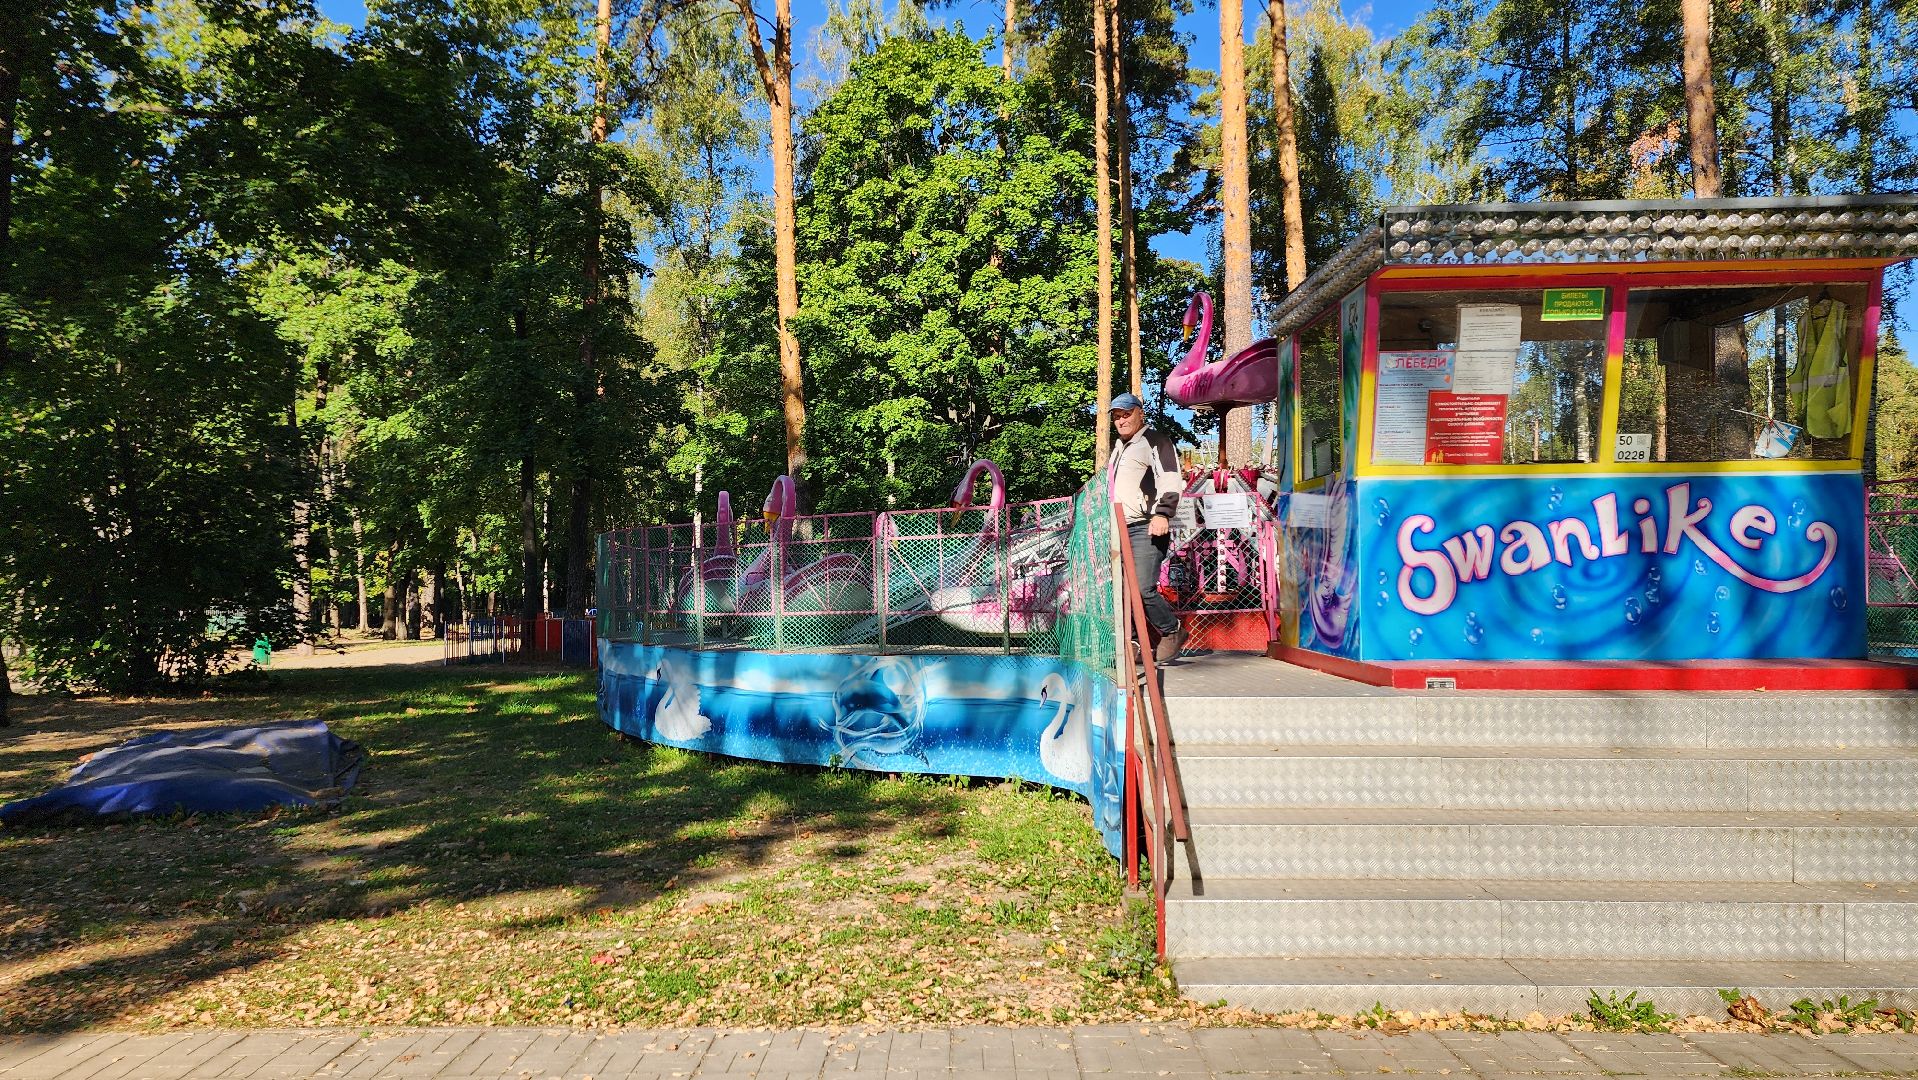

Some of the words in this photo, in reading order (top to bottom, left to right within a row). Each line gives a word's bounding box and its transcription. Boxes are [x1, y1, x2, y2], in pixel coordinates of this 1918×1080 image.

[1554, 300, 1594, 308] ПРОДАЮТСЯ
[1546, 308, 1571, 316] ТОЛЬКО
[1396, 356, 1447, 369] ЛЕБЕДИ
[1619, 435, 1633, 446] 50
[1617, 450, 1645, 460] 0228
